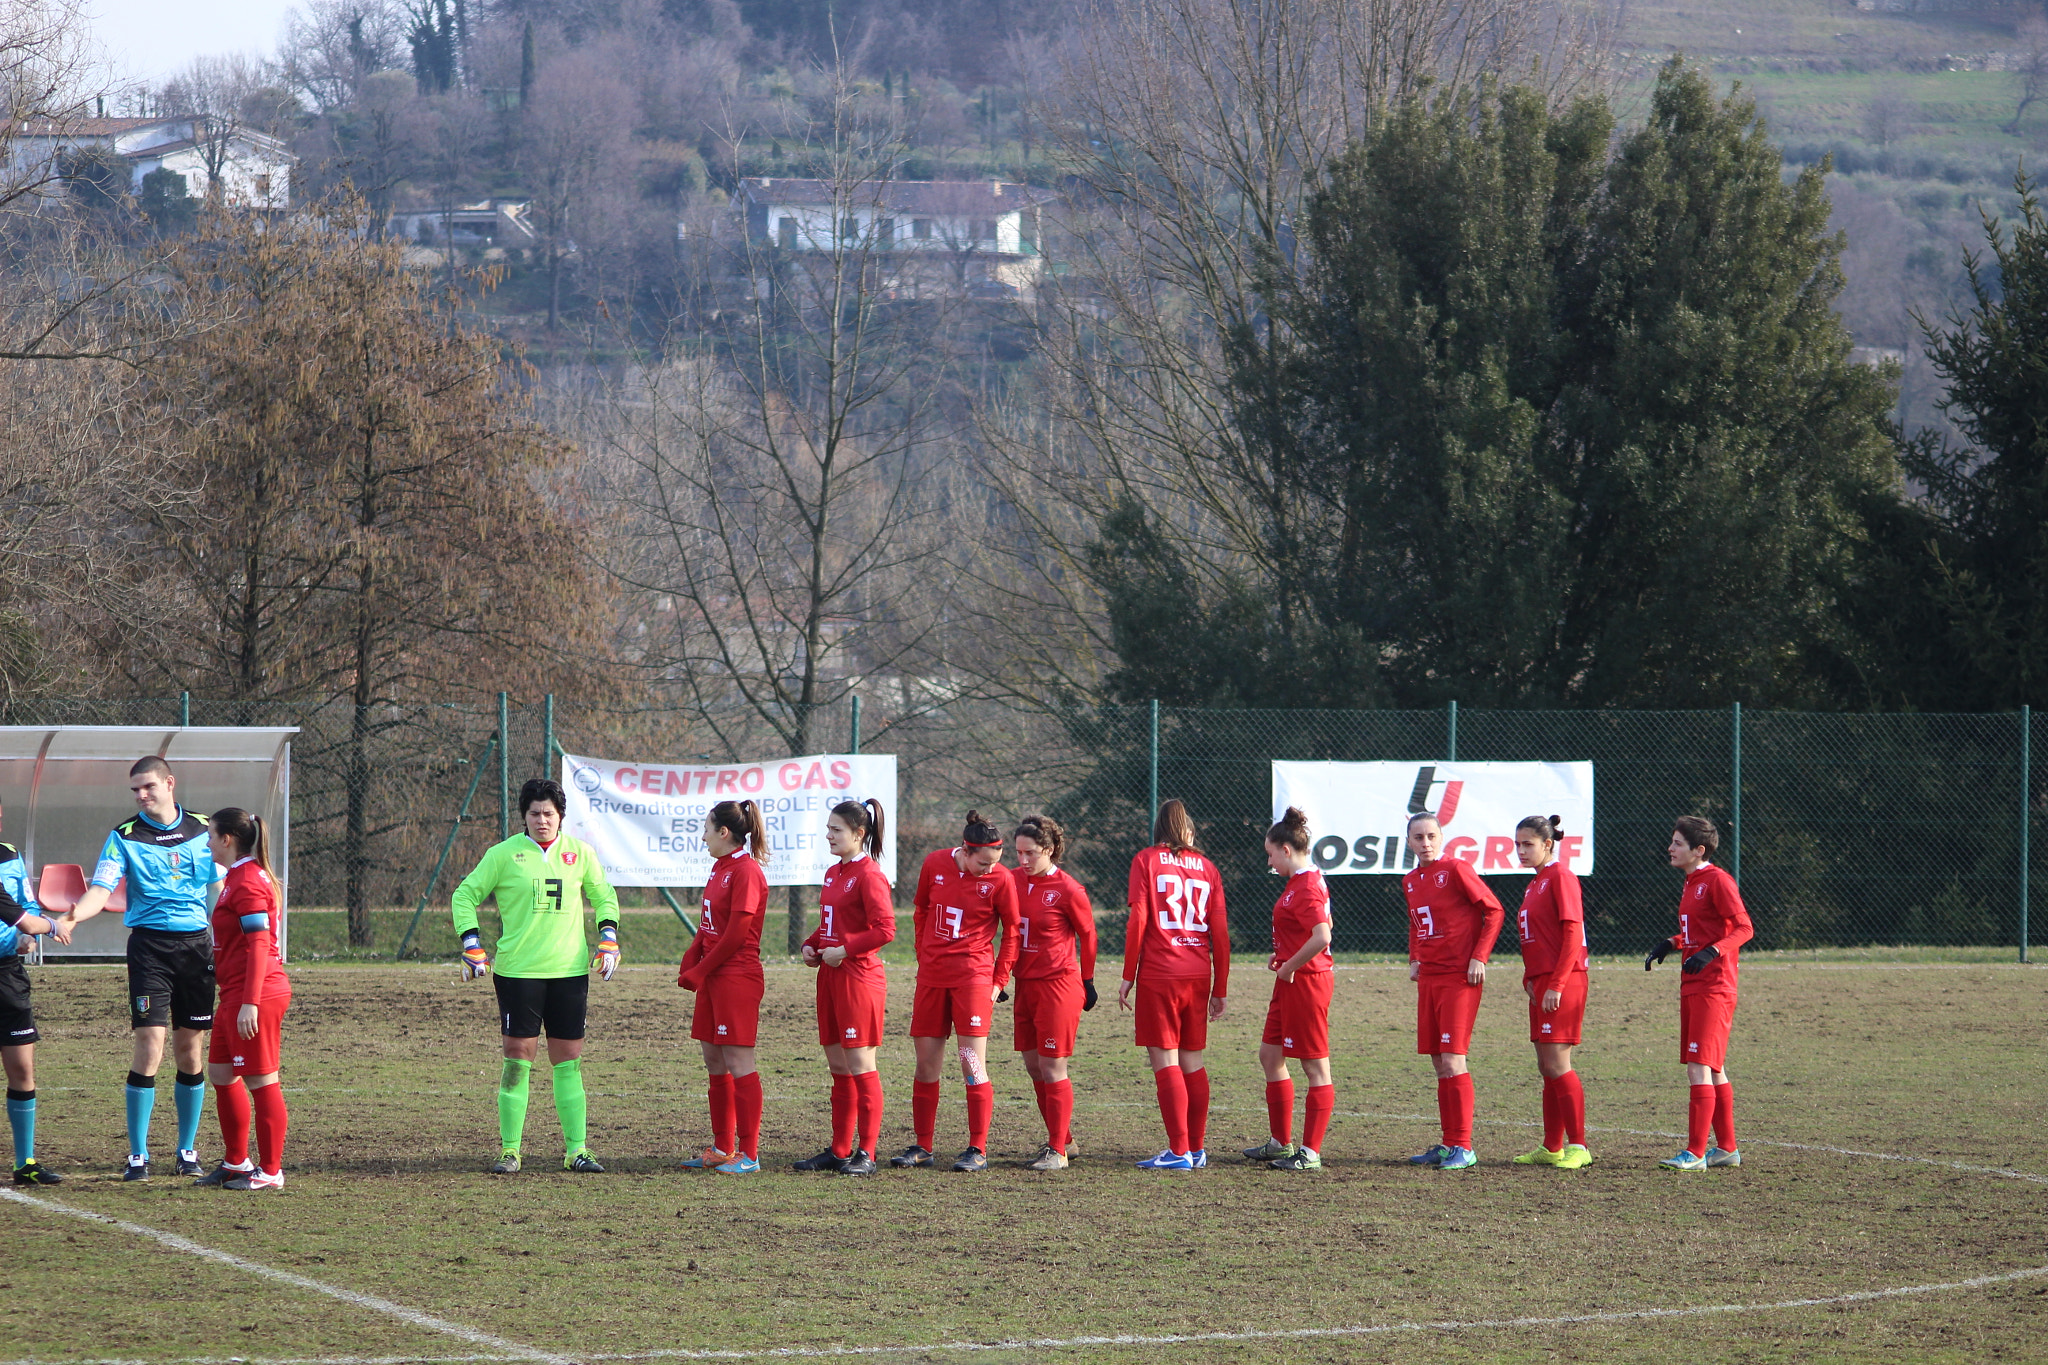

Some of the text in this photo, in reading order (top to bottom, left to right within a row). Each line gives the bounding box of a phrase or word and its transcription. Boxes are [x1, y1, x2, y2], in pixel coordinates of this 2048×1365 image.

[614, 761, 851, 795] CENTRO GAS
[589, 797, 706, 816] Rivenditore
[156, 833, 184, 841] DIADORA
[683, 856, 698, 865] Via
[615, 866, 673, 875] Castegnero
[1157, 874, 1210, 932] 30
